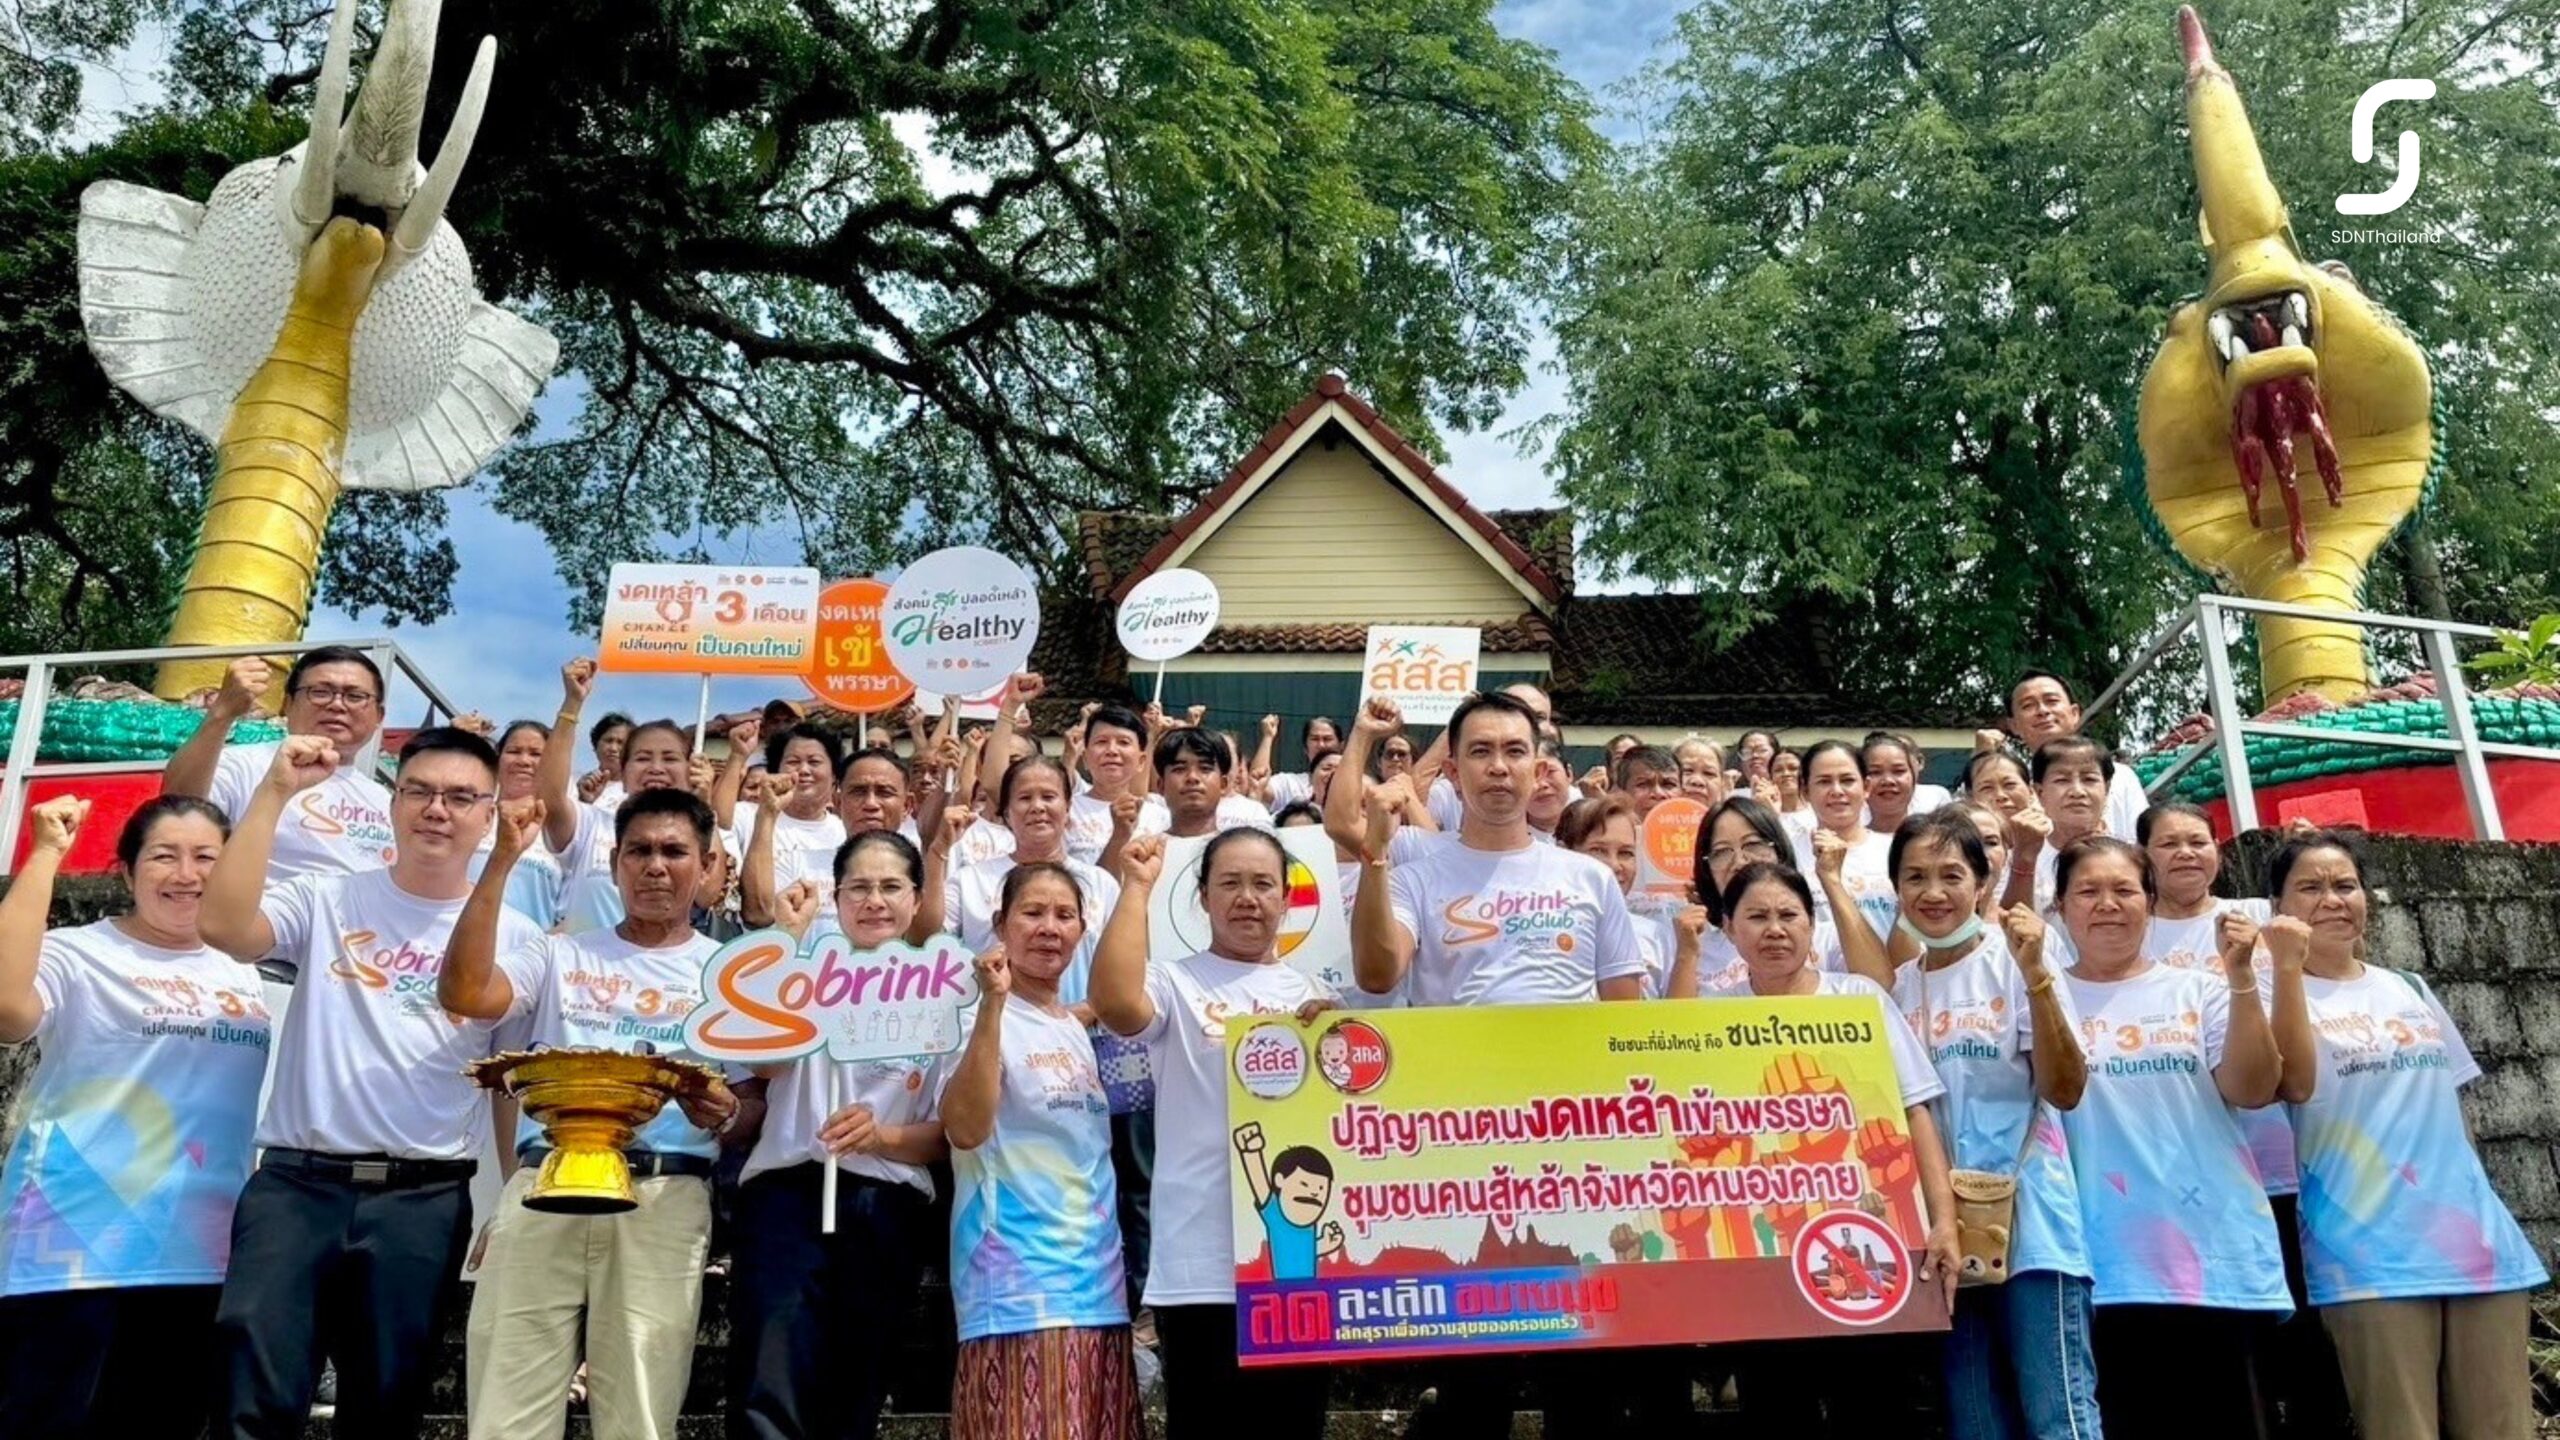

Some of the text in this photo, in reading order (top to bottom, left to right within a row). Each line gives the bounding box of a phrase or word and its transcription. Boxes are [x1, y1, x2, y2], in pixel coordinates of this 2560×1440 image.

[618, 580, 807, 624] งดเหล้า 3 เดือน
[820, 604, 881, 621] งดเห
[892, 611, 1025, 647] Healthy
[1123, 608, 1209, 632] Healthy
[695, 634, 803, 656] เป็นคนใหม่
[825, 674, 900, 692] พรรษา
[1370, 658, 1472, 692] สสส
[300, 792, 391, 835] Sobrink
[346, 823, 394, 843] SoClu
[1441, 890, 1573, 945] Sobrink
[329, 930, 445, 988] Sobri
[634, 987, 662, 1015] 3
[698, 944, 966, 1050] Sobrink
[1608, 1015, 1873, 1053] ชัยชนะที่ยิ่งใหญ่ คือ ชนะใจตนเอง
[2116, 1024, 2143, 1051] 3
[1244, 1047, 1298, 1072] สสส
[2105, 1052, 2199, 1077] เป็นคนใหม่
[1249, 1290, 1331, 1345] ลด
[1338, 1278, 1448, 1321] ละเลิก
[1335, 1314, 1580, 1343] เลิกสุราเพื่อความสุขของครอบครัว
